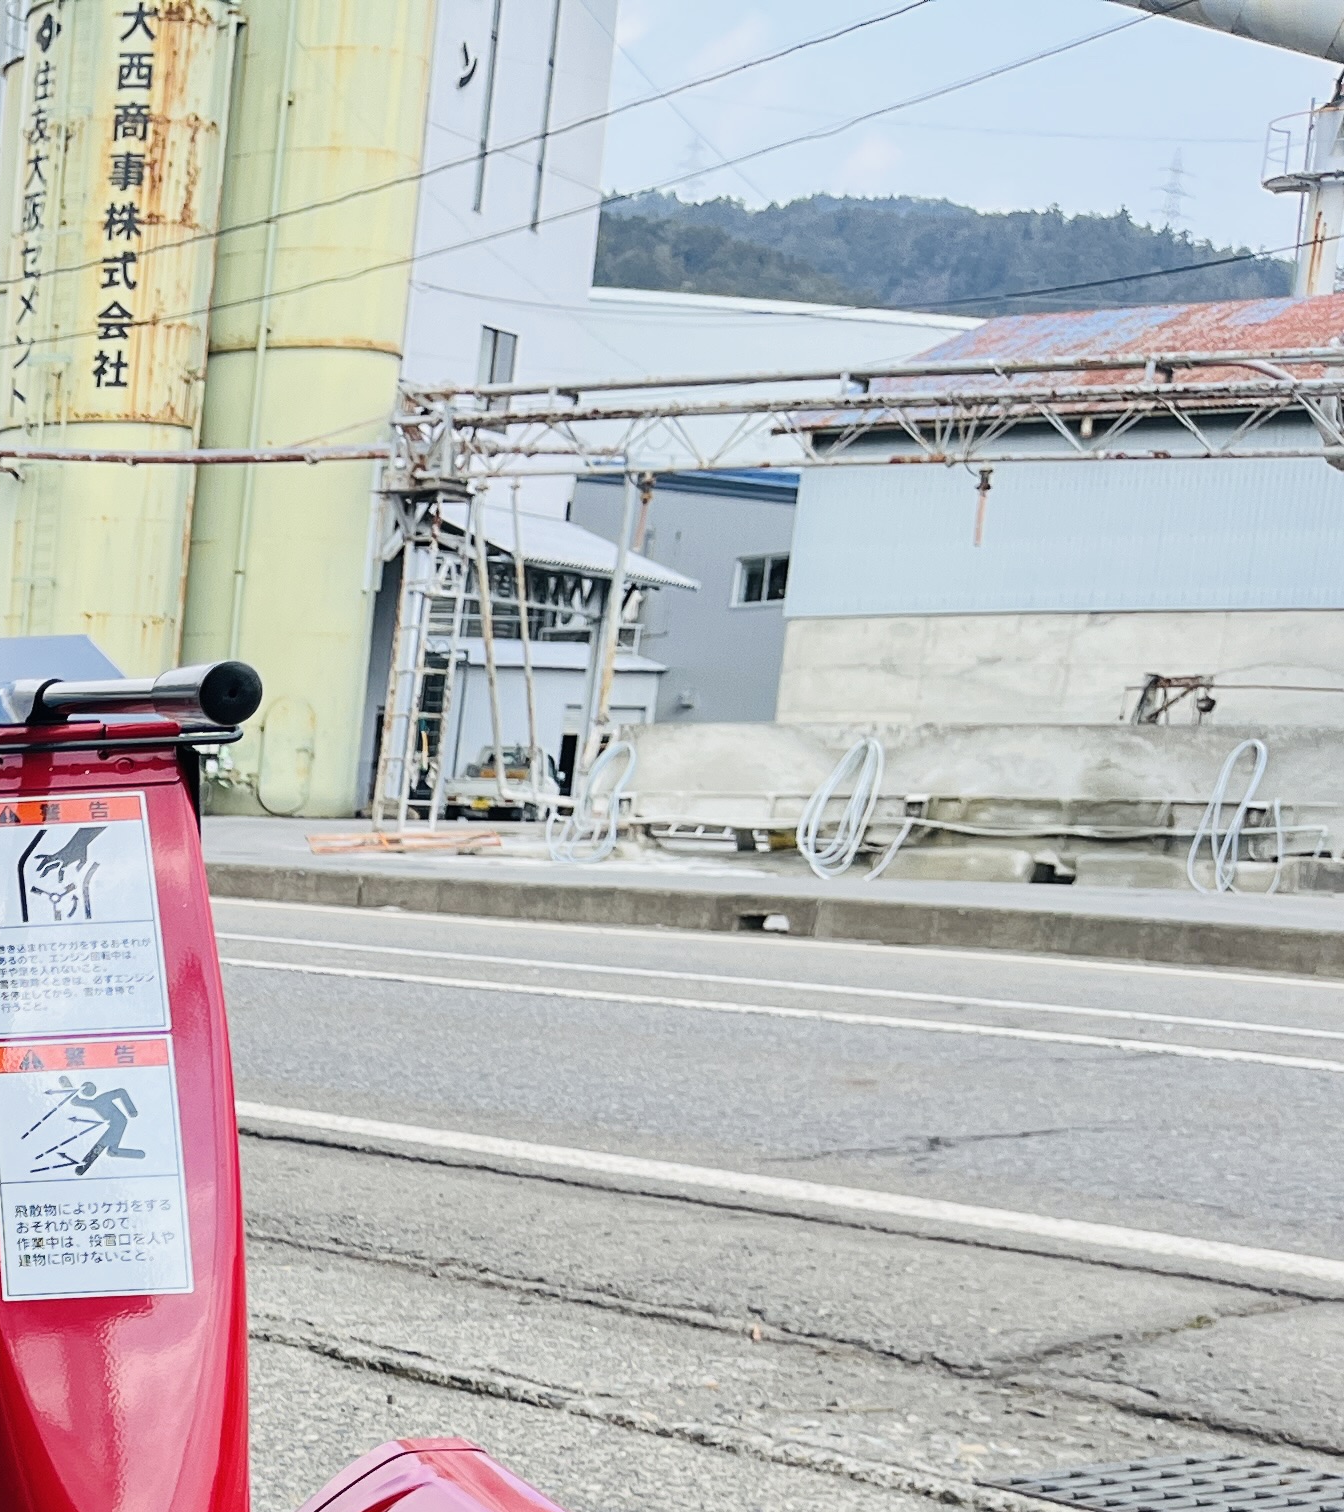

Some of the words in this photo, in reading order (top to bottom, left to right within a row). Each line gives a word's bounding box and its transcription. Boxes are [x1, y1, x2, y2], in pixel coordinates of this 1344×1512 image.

[91, 2, 158, 388] 大西商事株式会社
[15, 1199, 171, 1218] 飛散物によりケガをする
[19, 1249, 154, 1267] 建物に向けないこと。
